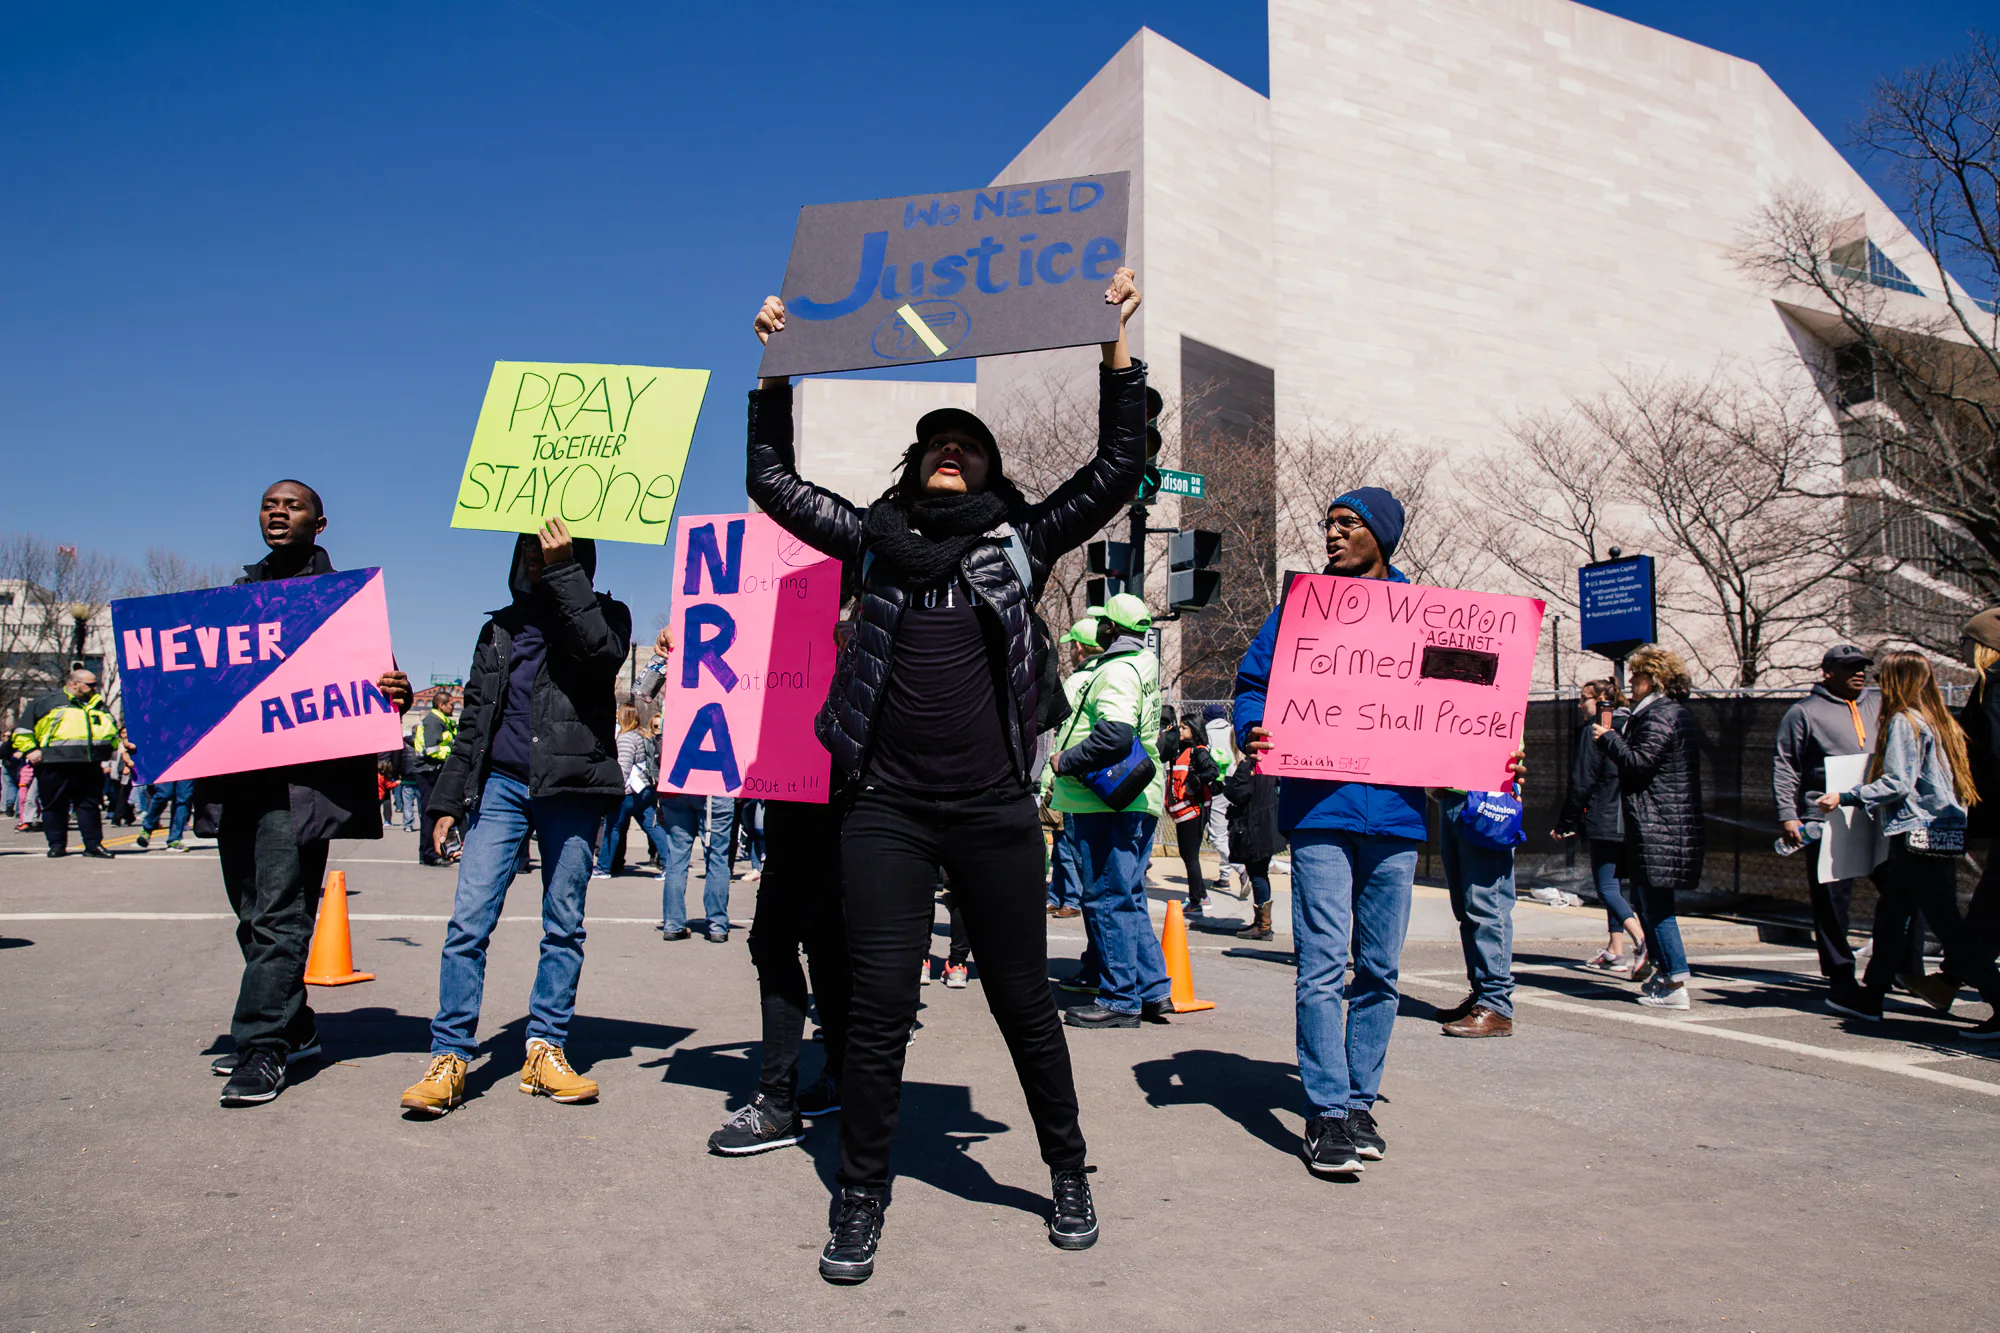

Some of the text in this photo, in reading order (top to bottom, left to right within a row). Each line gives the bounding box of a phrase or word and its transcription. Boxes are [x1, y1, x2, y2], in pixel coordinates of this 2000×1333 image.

[904, 182, 1105, 230] We NEED
[786, 231, 1123, 321] Justice
[509, 372, 657, 432] PRAY
[532, 434, 627, 461] TOGETHER
[1191, 477, 1200, 485] DR
[1191, 486, 1200, 494] NW
[1620, 564, 1637, 572] Capitol
[1302, 580, 1516, 634] NO Weapon
[1591, 587, 1618, 595] Smithsonian
[123, 622, 285, 672] NEVER
[1293, 638, 1415, 679] Formed
[261, 679, 392, 734] AGAIN
[1282, 699, 1522, 739] Me Shall Prosper
[1281, 754, 1371, 770] Isaiah 54:17
